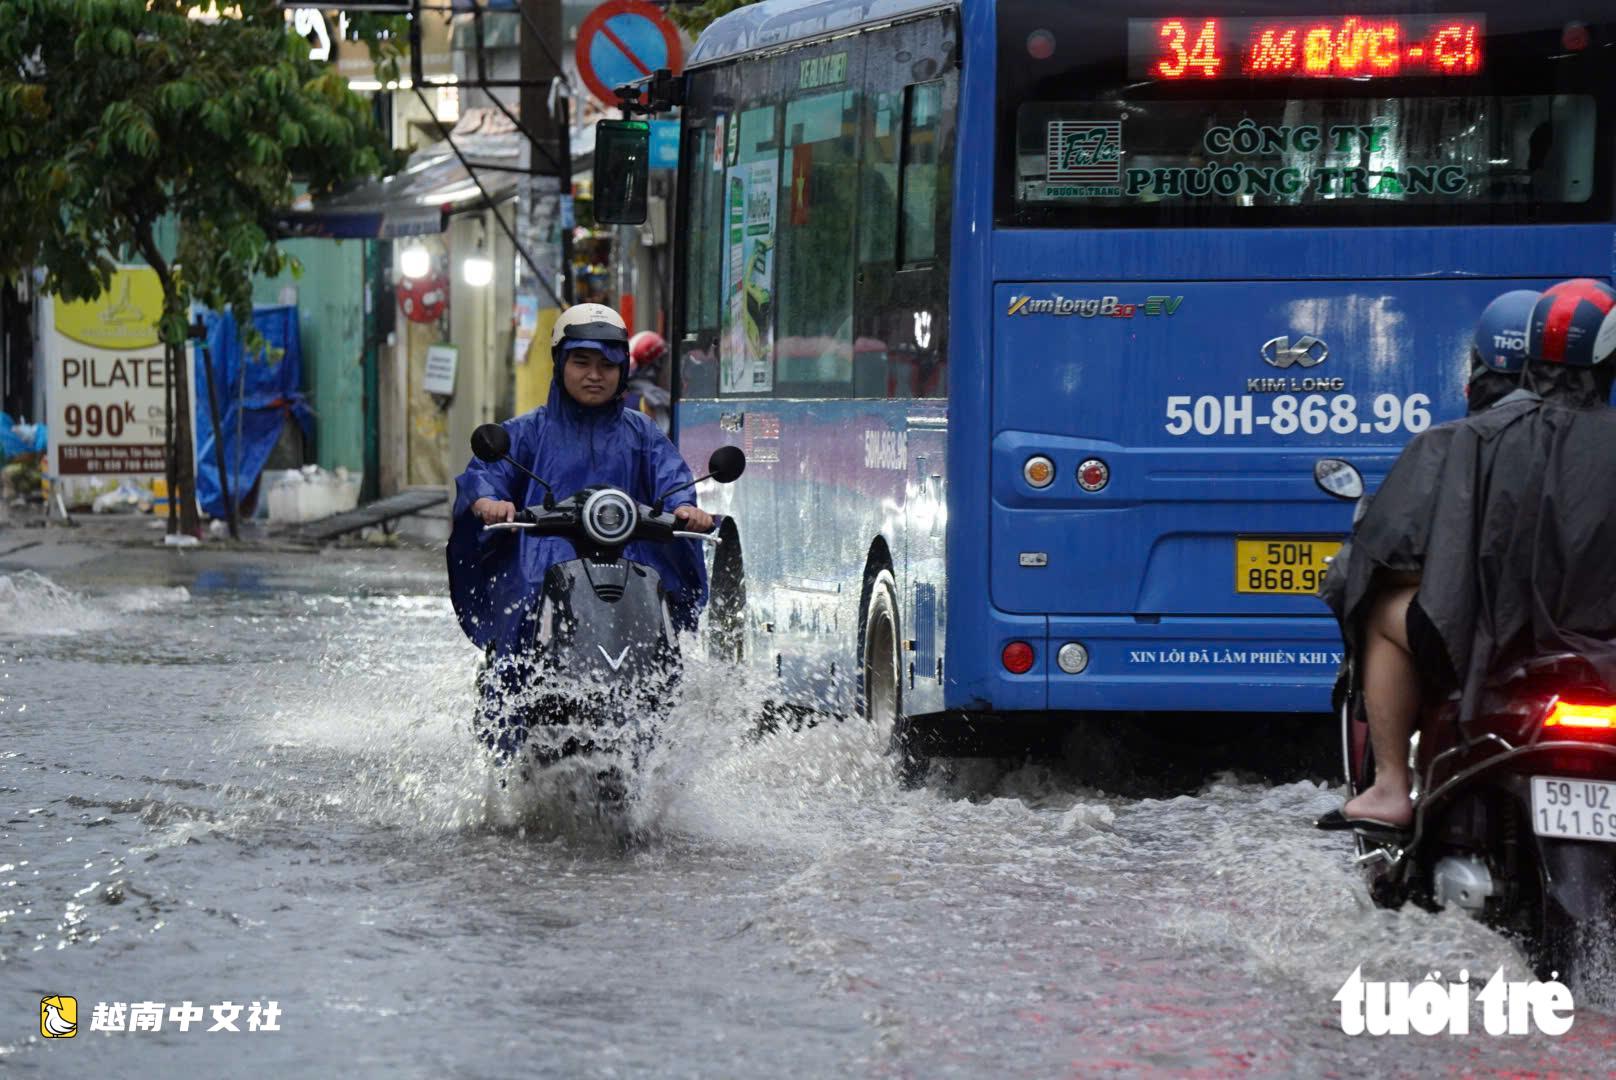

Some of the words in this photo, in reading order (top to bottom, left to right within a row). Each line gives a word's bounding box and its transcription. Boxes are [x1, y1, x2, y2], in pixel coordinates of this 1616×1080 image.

[1159, 21, 1220, 76] 34
[1204, 119, 1320, 154] CÔNG
[1331, 125, 1391, 154] TY
[1087, 186, 1120, 197] TRANG
[1126, 162, 1300, 196] PHƯƠNG
[1314, 167, 1468, 196] TRANG
[62, 357, 176, 388] PILATE
[1247, 377, 1286, 392] KIM
[1291, 377, 1345, 391] LONG
[64, 400, 136, 437] 990k
[1165, 393, 1431, 435] 50H-868.96
[1267, 543, 1312, 566] 50H
[1130, 651, 1156, 663] XIN
[1189, 649, 1212, 663] ĐÃ
[1213, 649, 1246, 664] LÀM
[1300, 652, 1327, 664] KHI
[1331, 652, 1345, 664] X
